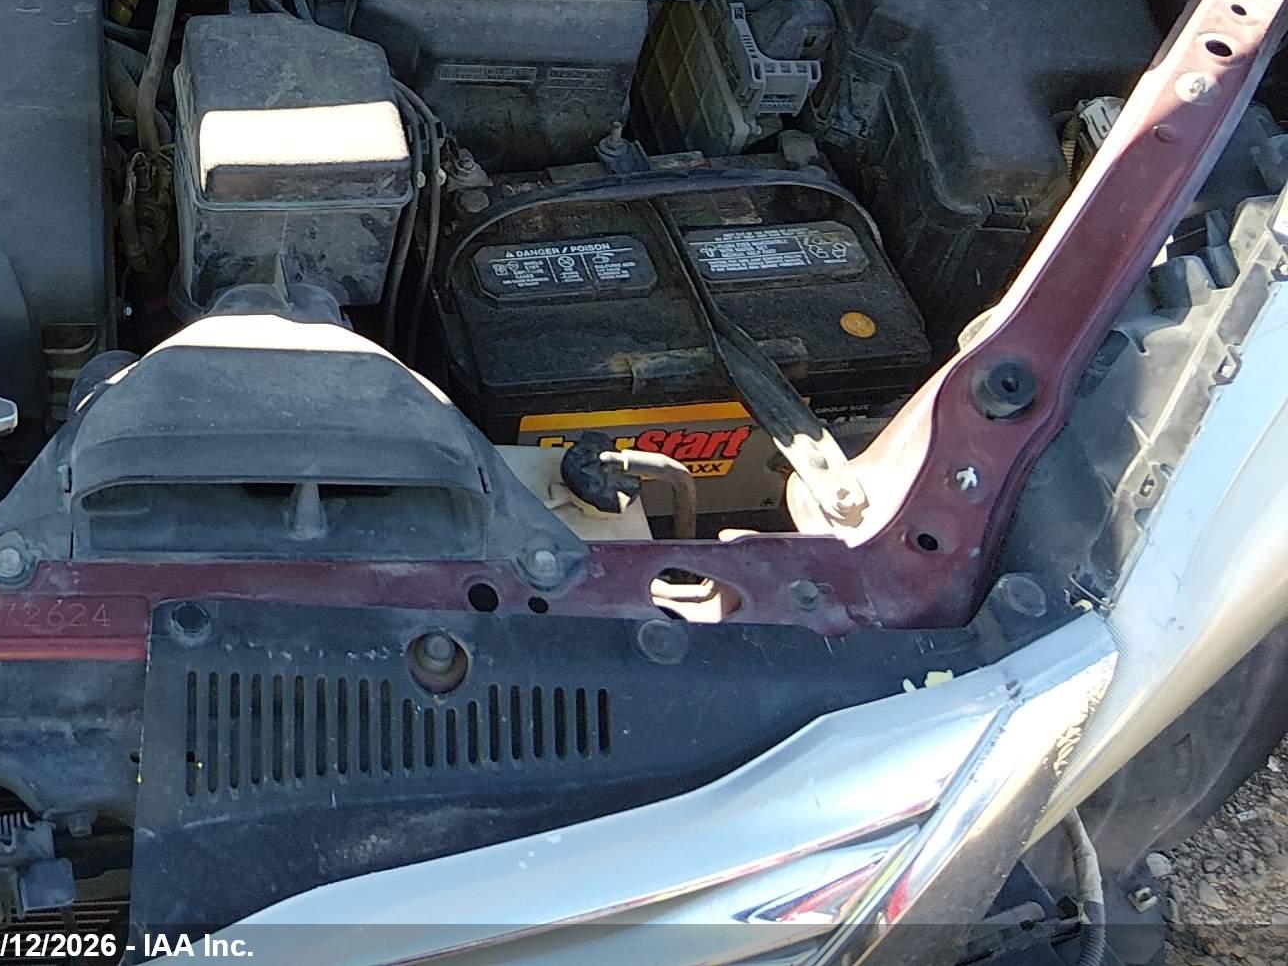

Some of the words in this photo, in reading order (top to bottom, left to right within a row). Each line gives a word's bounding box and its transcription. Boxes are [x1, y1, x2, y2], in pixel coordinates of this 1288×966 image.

[516, 247, 561, 258] DANGER
[570, 242, 611, 253] POISON
[5, 602, 111, 627] 72624
